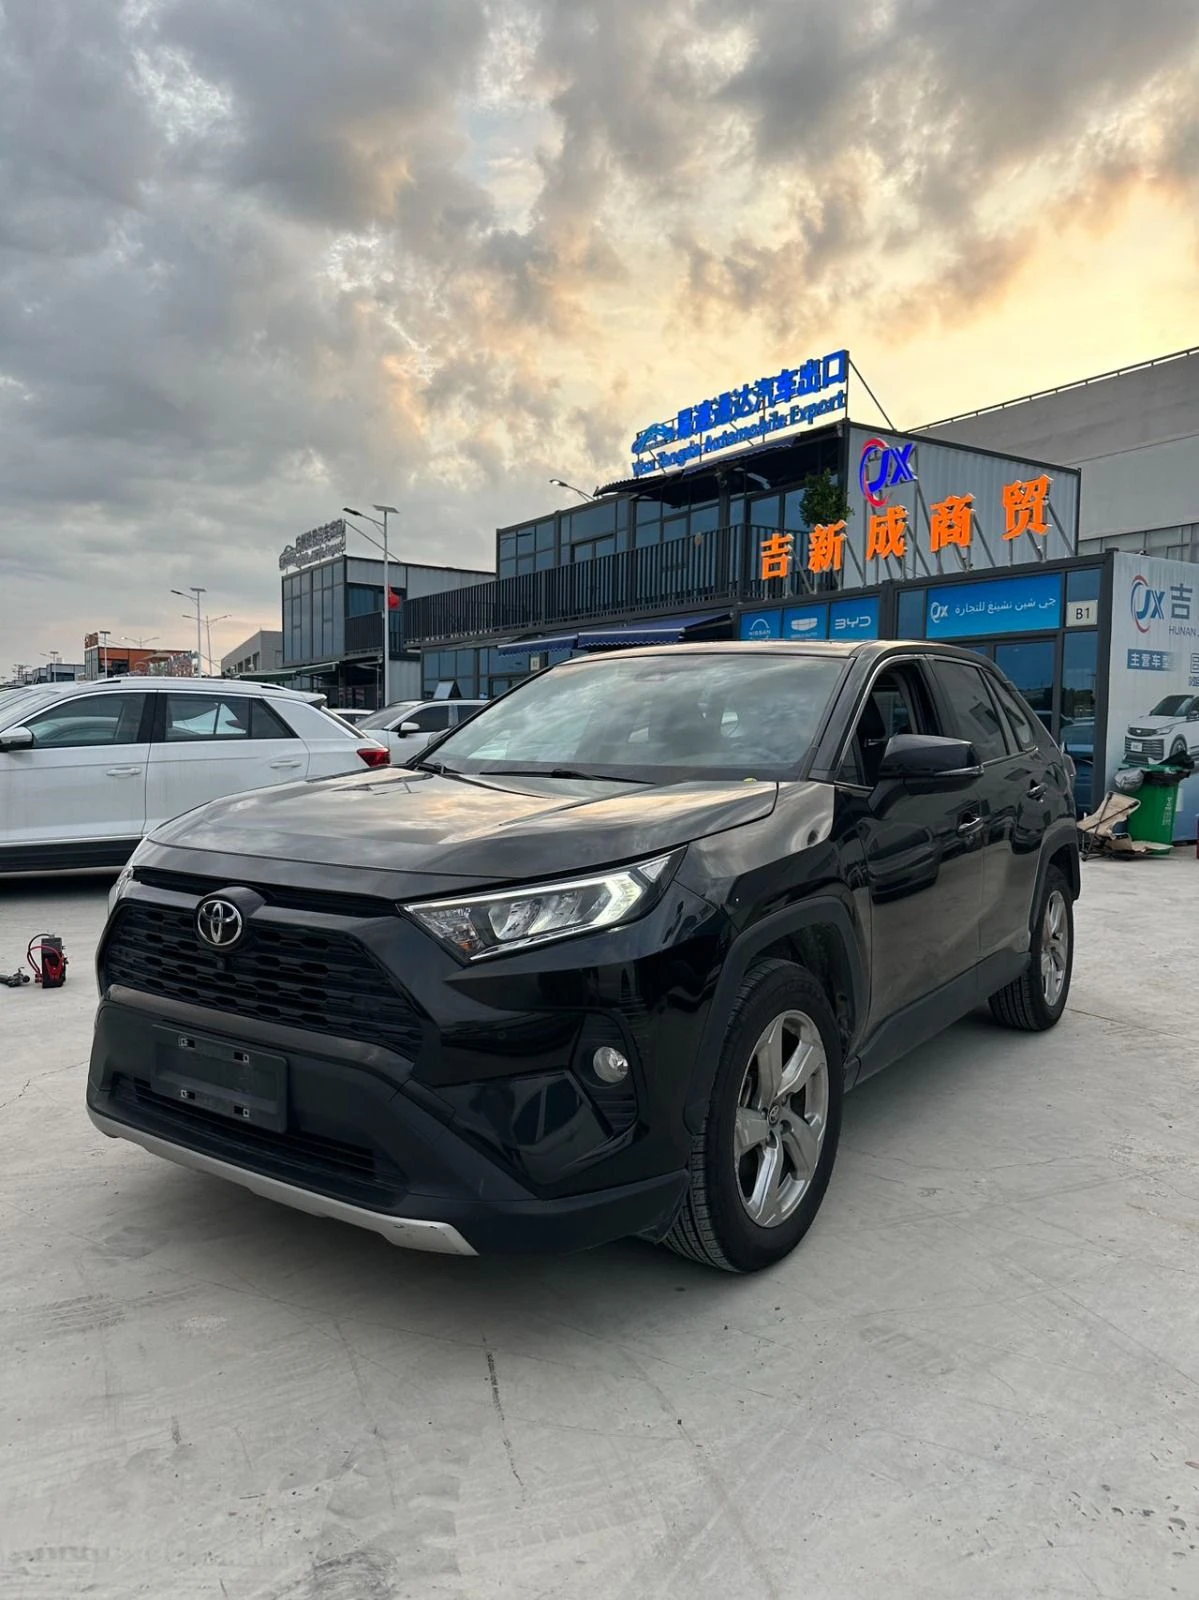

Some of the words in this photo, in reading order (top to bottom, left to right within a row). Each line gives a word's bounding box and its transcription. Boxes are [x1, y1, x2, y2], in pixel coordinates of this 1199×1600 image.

[704, 411, 788, 453] Automobile
[789, 389, 847, 425] Export
[760, 473, 1053, 581] 吉新成商贸
[1075, 607, 1090, 620] B1
[1170, 583, 1193, 620] 吉
[834, 615, 872, 630] BYD
[1168, 625, 1197, 637] HUNAN
